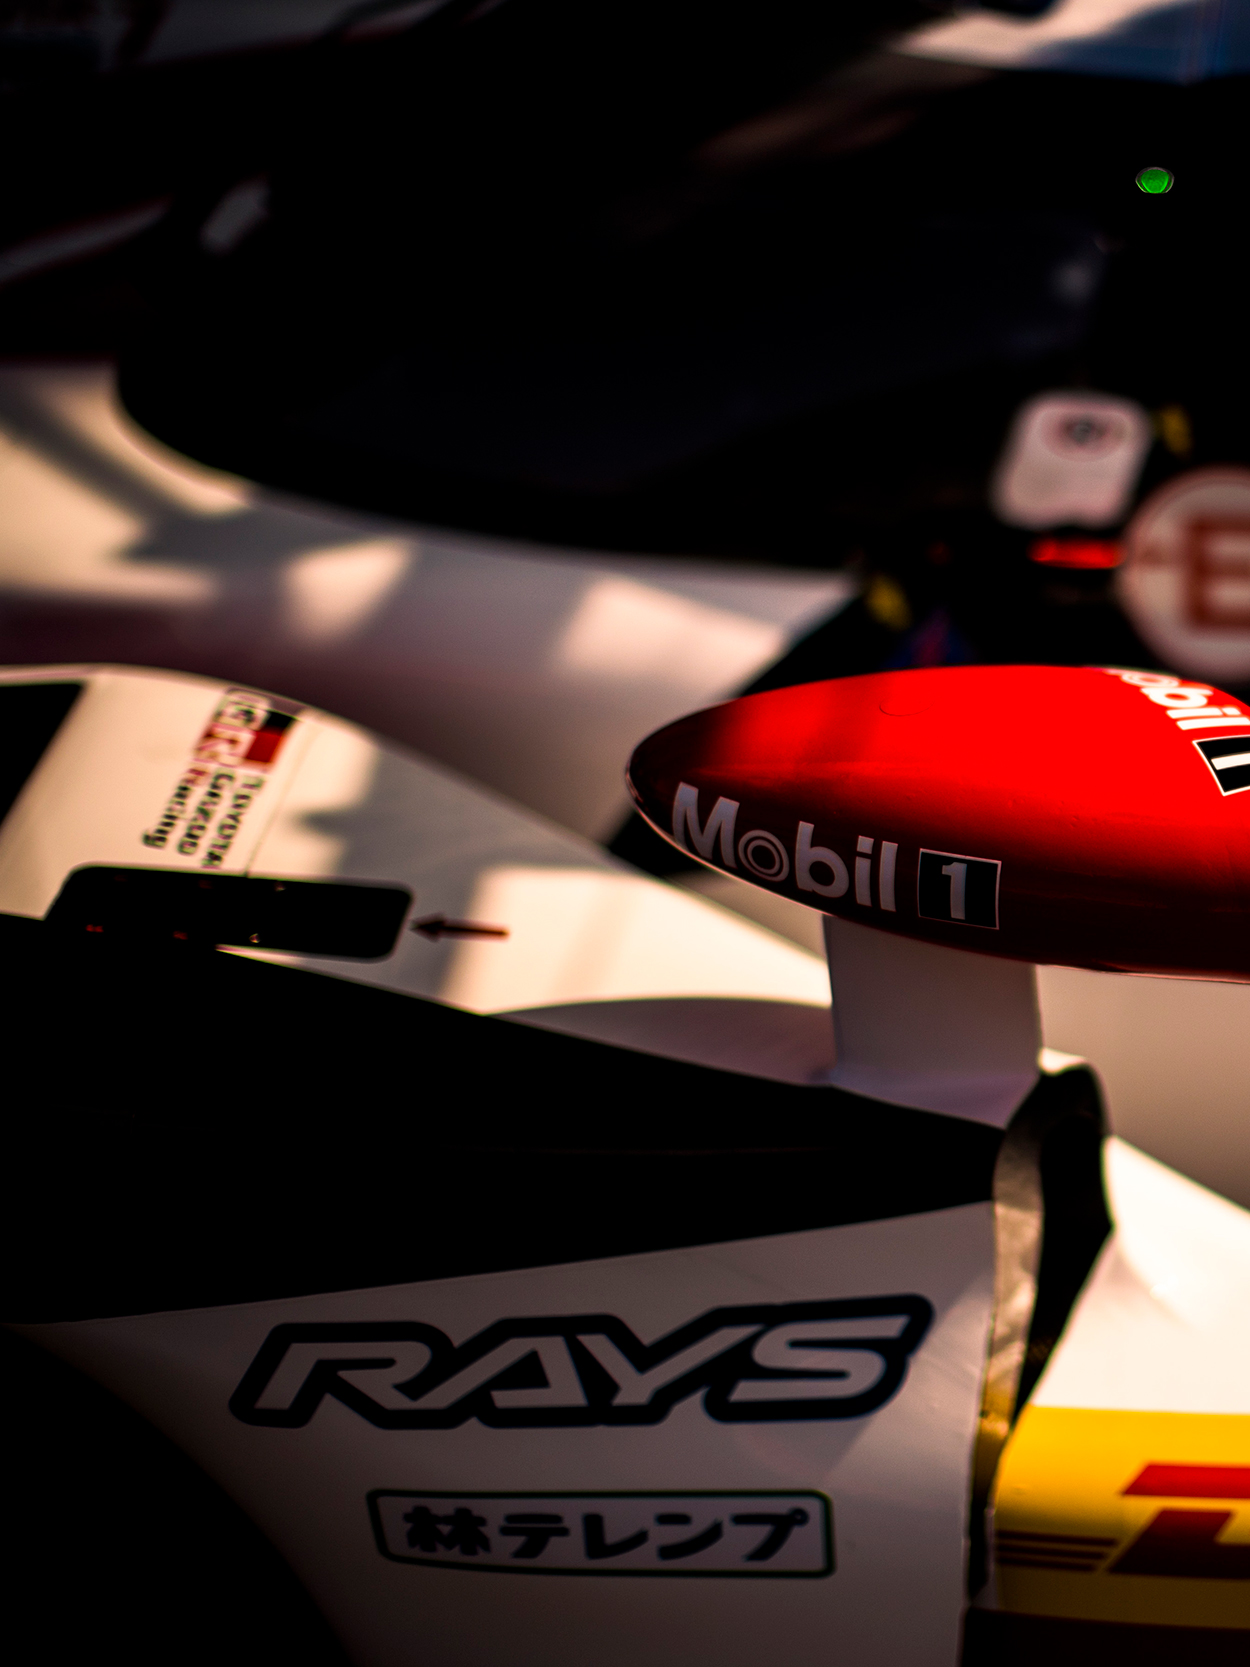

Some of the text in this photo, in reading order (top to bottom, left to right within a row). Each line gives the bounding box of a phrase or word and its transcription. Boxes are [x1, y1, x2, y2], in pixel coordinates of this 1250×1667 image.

[201, 777, 264, 869] TOYOTA
[672, 782, 898, 911] Mobil
[250, 1311, 917, 1414] RAYS
[404, 1506, 809, 1562] 林テレンプ
